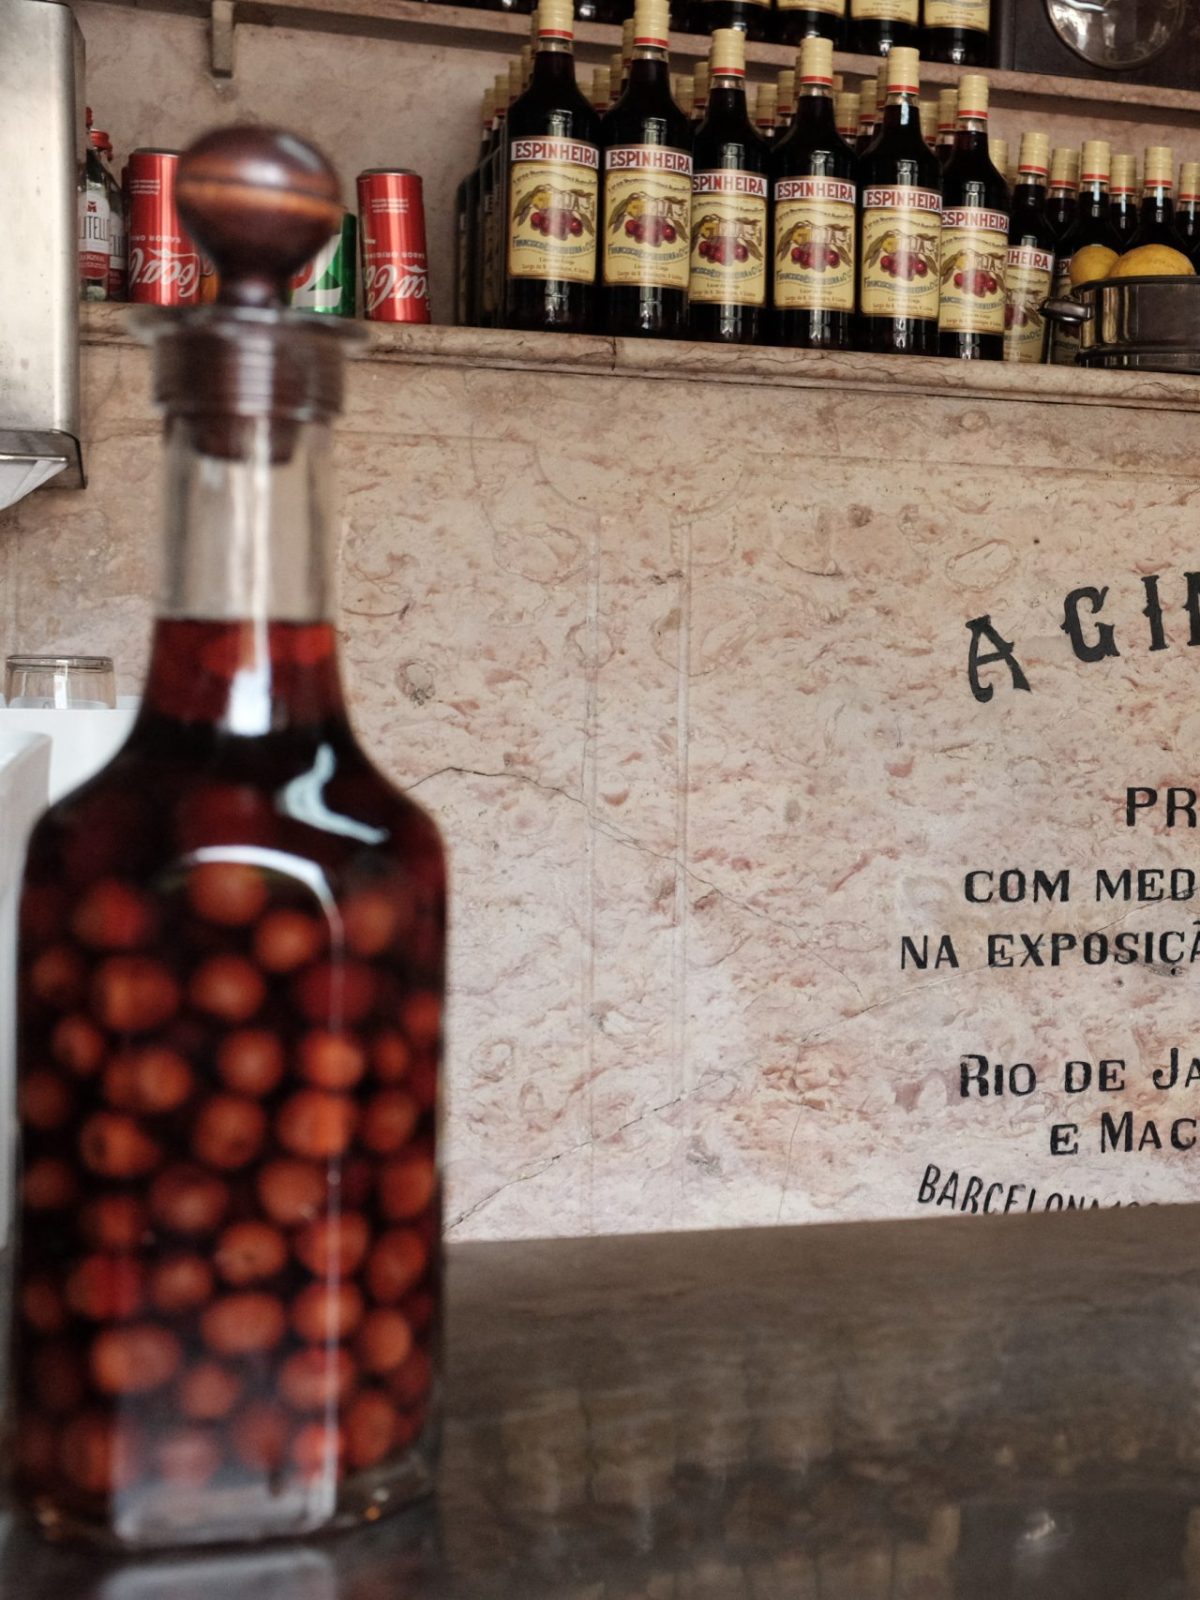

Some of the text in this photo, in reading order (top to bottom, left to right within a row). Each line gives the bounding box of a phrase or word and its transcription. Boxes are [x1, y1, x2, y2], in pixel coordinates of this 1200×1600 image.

[514, 142, 597, 167] ESPINHEIRA
[609, 150, 691, 173] ESPINHEIRA
[692, 175, 764, 194] SPINHEIRA
[777, 182, 853, 201] ESPINHEIRA
[866, 190, 941, 211] ESPINHEIRA
[942, 211, 1008, 231] ESPINHEIRA
[966, 613, 1031, 703] A
[964, 867, 1070, 903] COM
[901, 934, 960, 970] NA
[1064, 1059, 1126, 1093] DE
[1049, 1123, 1079, 1156] E
[917, 1163, 1101, 1214] BARCELO
